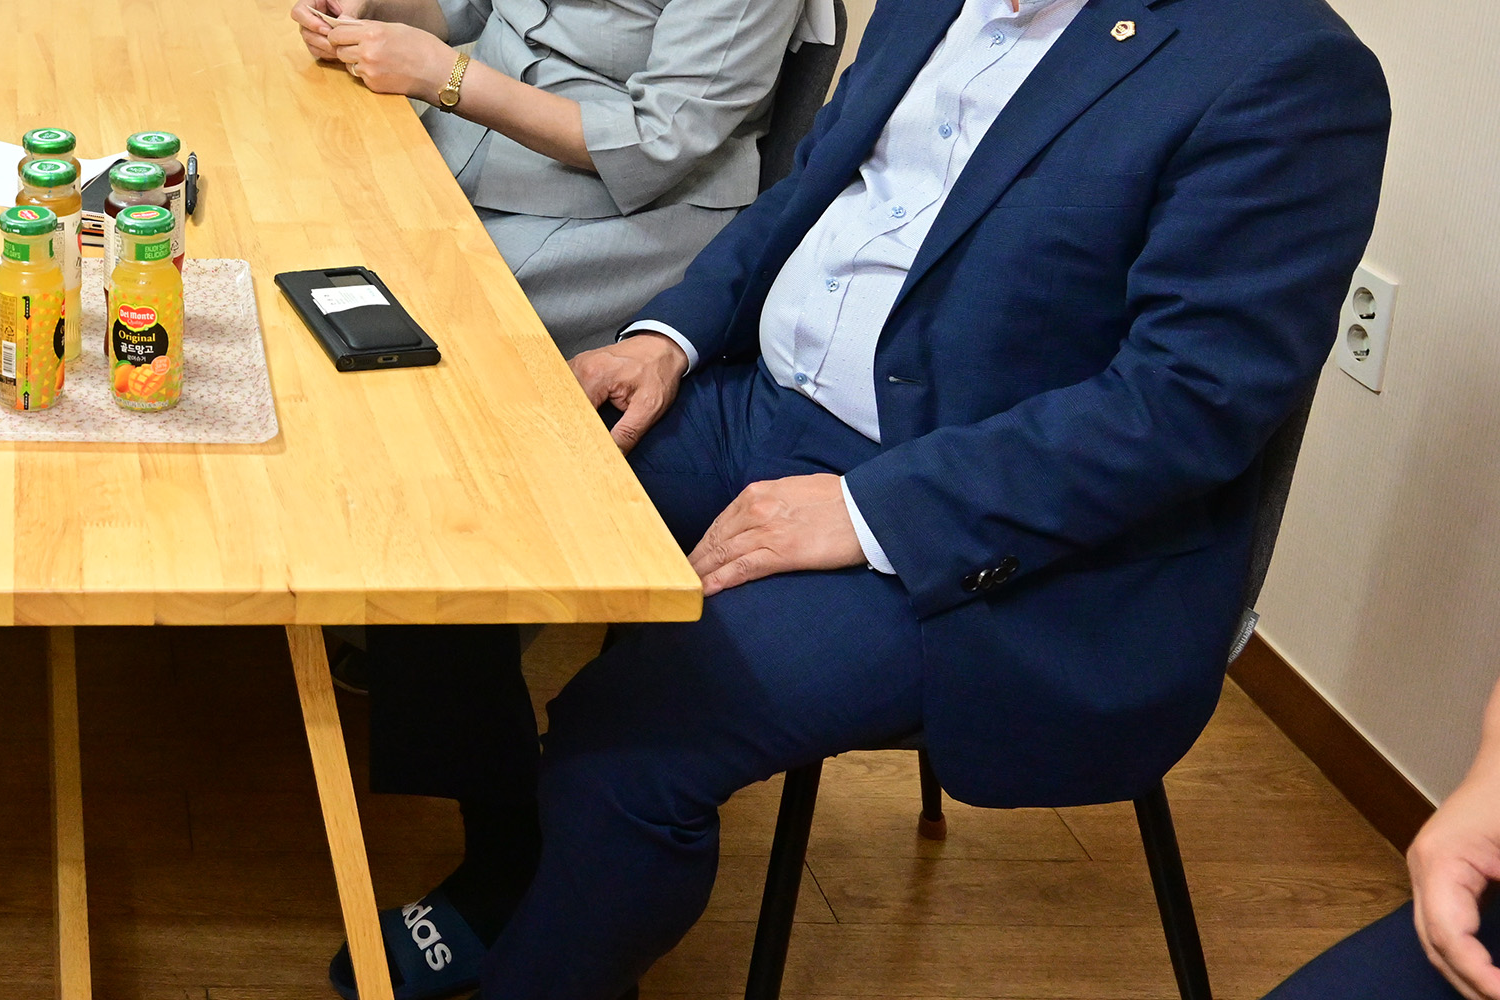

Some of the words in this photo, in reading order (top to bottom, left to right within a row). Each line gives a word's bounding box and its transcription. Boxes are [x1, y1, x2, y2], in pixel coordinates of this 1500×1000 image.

[120, 309, 129, 318] Del
[130, 312, 155, 320] Monte
[118, 330, 156, 344] Original
[120, 342, 154, 355] 골드망고
